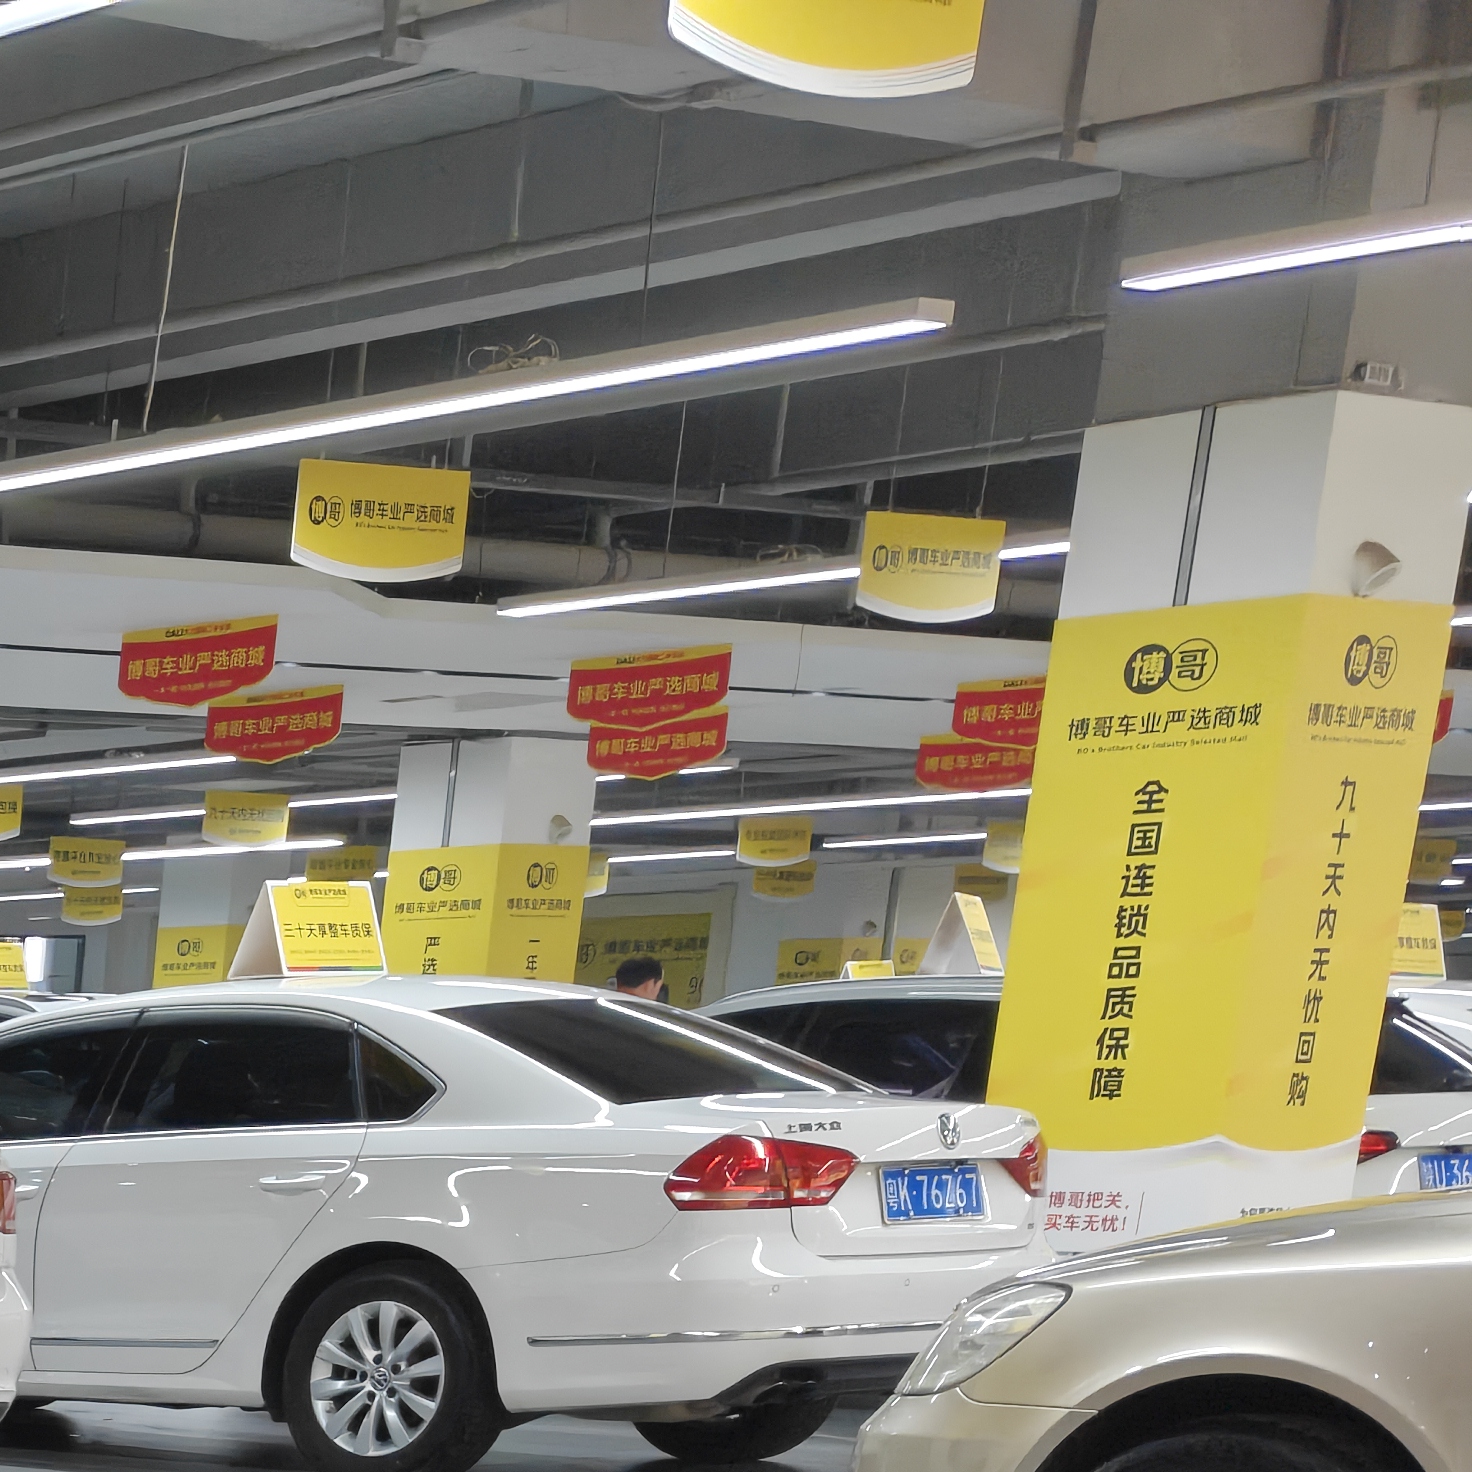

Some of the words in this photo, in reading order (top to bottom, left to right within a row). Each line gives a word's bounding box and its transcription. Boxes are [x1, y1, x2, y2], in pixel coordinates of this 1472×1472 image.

[1128, 643, 1214, 690] 博哥
[1068, 703, 1263, 742] 博哥车业严选商城
[283, 922, 373, 938] 三十天享整车质保
[1089, 780, 1170, 1102] 全国连锁品质保障
[1286, 775, 1358, 1108] 九十天内无忧回购
